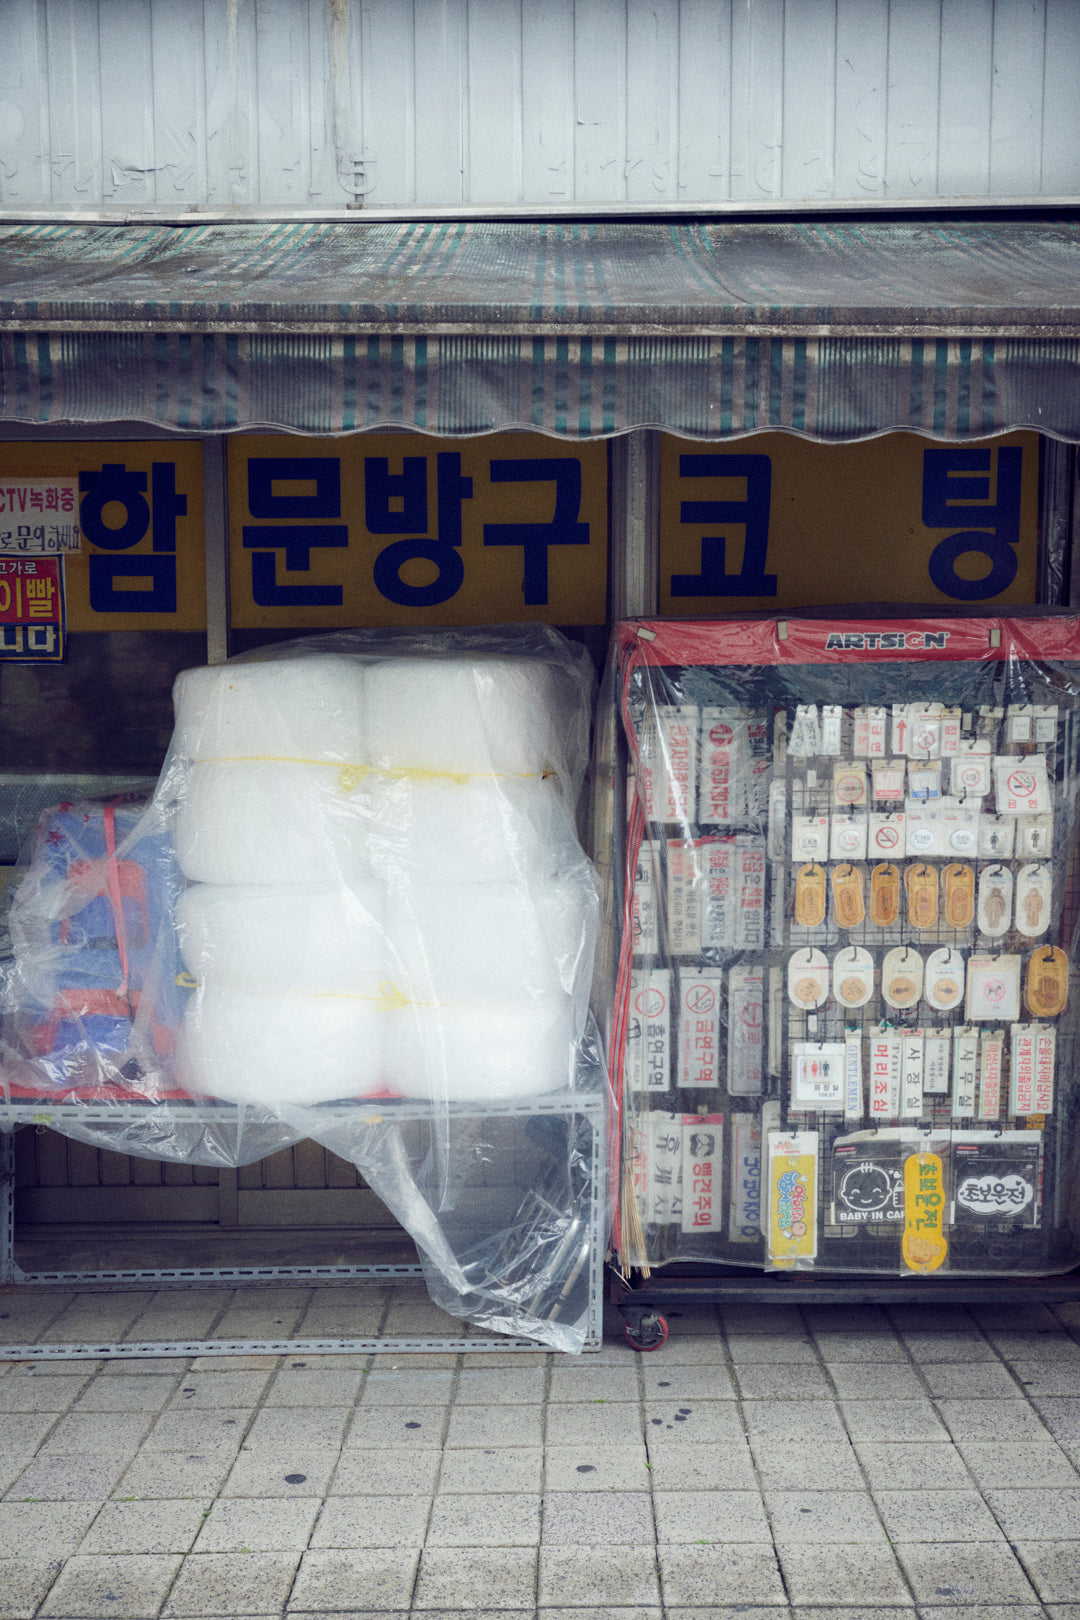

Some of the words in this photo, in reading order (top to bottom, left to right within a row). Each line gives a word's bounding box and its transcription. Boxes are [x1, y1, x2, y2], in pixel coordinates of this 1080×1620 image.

[79, 462, 188, 613] 함
[242, 452, 590, 607] 문방구
[648, 1023, 665, 1085] 흡연구역
[694, 1019, 714, 1081] 금연구역
[847, 1045, 858, 1111] GENTLEMEN
[874, 1045, 888, 1112] 머리조심
[907, 1048, 920, 1109] 사장실
[959, 1049, 974, 1107] 사무실
[984, 1044, 999, 1116] 미성년자출입금지
[1018, 1038, 1031, 1111] 관계자외출입금지
[692, 1162, 712, 1226] 맹견주의
[840, 1212, 869, 1222] BABY
[871, 1211, 884, 1220] IN
[916, 1162, 941, 1231] 초보운전
[964, 1183, 1027, 1204] 초보운전
